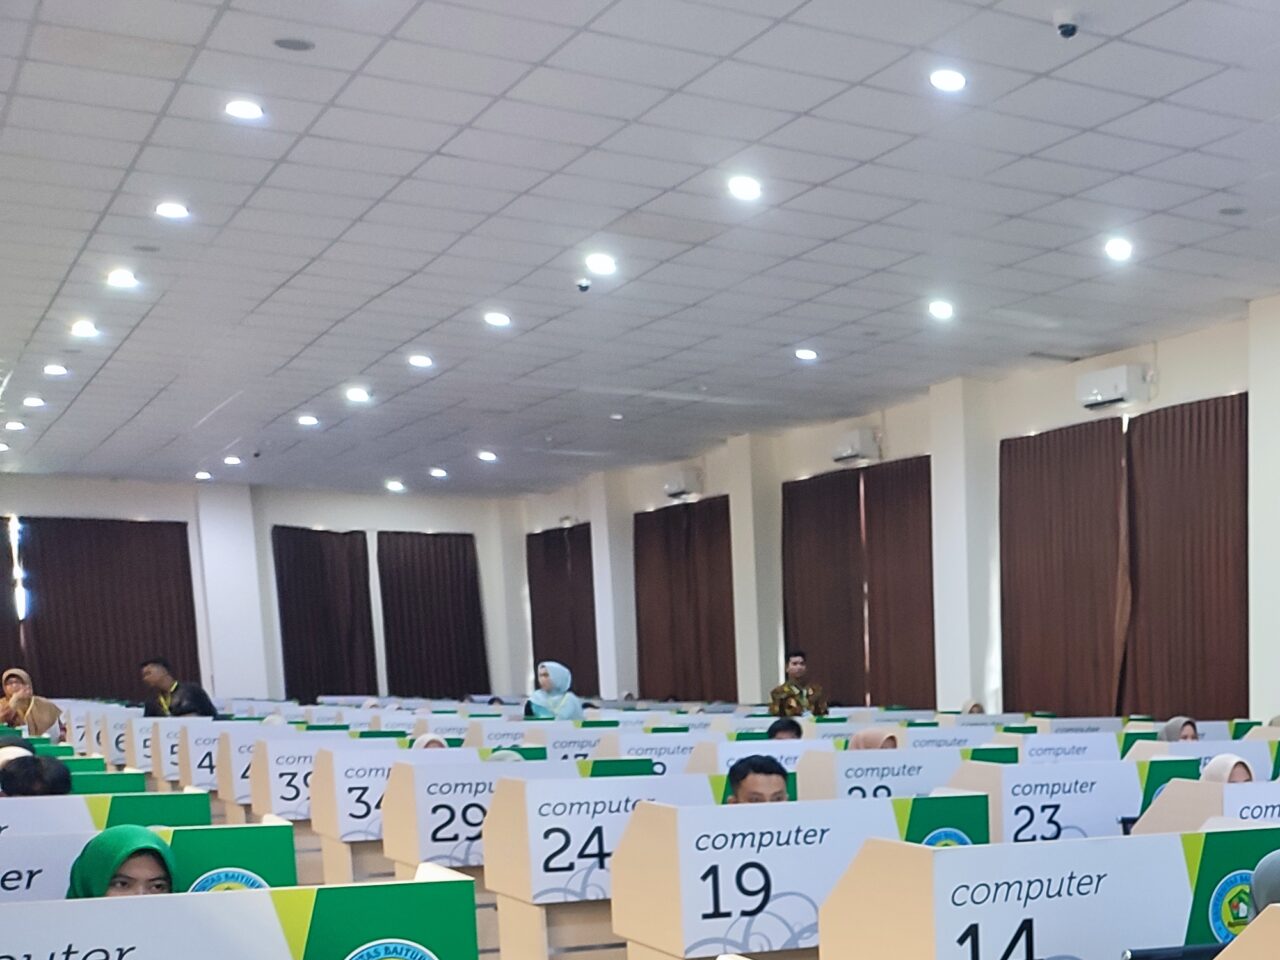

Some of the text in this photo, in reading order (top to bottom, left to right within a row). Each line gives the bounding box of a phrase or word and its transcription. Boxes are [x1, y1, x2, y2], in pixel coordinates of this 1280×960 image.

[1028, 745, 1088, 759] computer
[845, 764, 923, 780] computer
[1011, 780, 1096, 798] computer
[431, 803, 487, 843] 29
[695, 825, 830, 854] computer
[1013, 804, 1061, 842] 23
[543, 825, 613, 873] 24
[700, 861, 771, 920] 19
[951, 870, 1108, 909] computer
